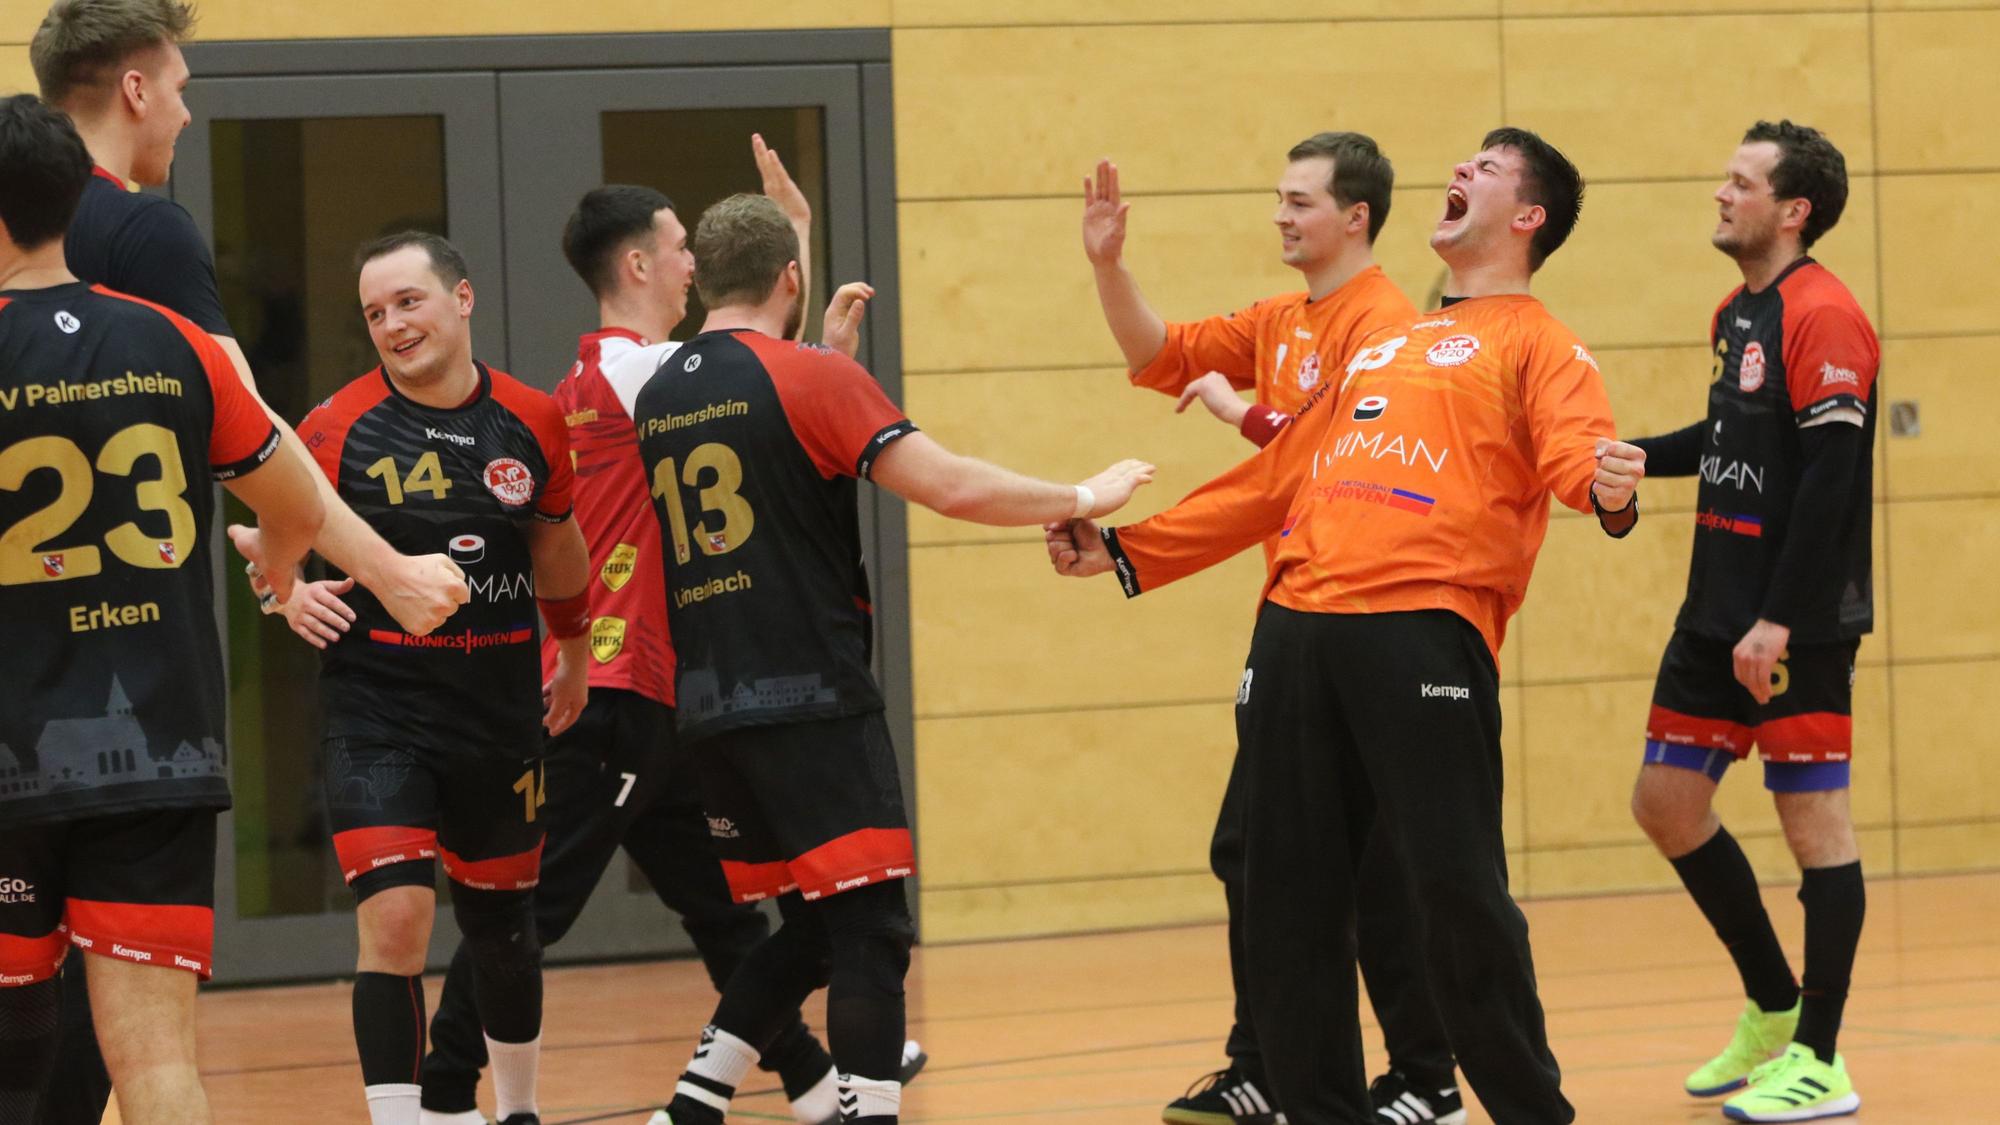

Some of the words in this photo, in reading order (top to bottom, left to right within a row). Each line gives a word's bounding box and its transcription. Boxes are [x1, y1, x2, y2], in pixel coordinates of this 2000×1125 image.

[25, 370, 183, 407] Palmersheim
[648, 399, 749, 437] Palmersheim
[425, 427, 476, 446] Kempa
[366, 451, 452, 505] 14
[0, 423, 197, 586] 23
[651, 442, 755, 566] 13
[605, 563, 632, 574] HUK
[467, 569, 533, 604] MAN
[69, 602, 160, 632] Erken
[593, 635, 622, 646] HUK
[1421, 683, 1470, 700] Kempa
[371, 853, 405, 868] Kempa
[836, 875, 870, 891] Kempa
[112, 943, 151, 961] Kempa
